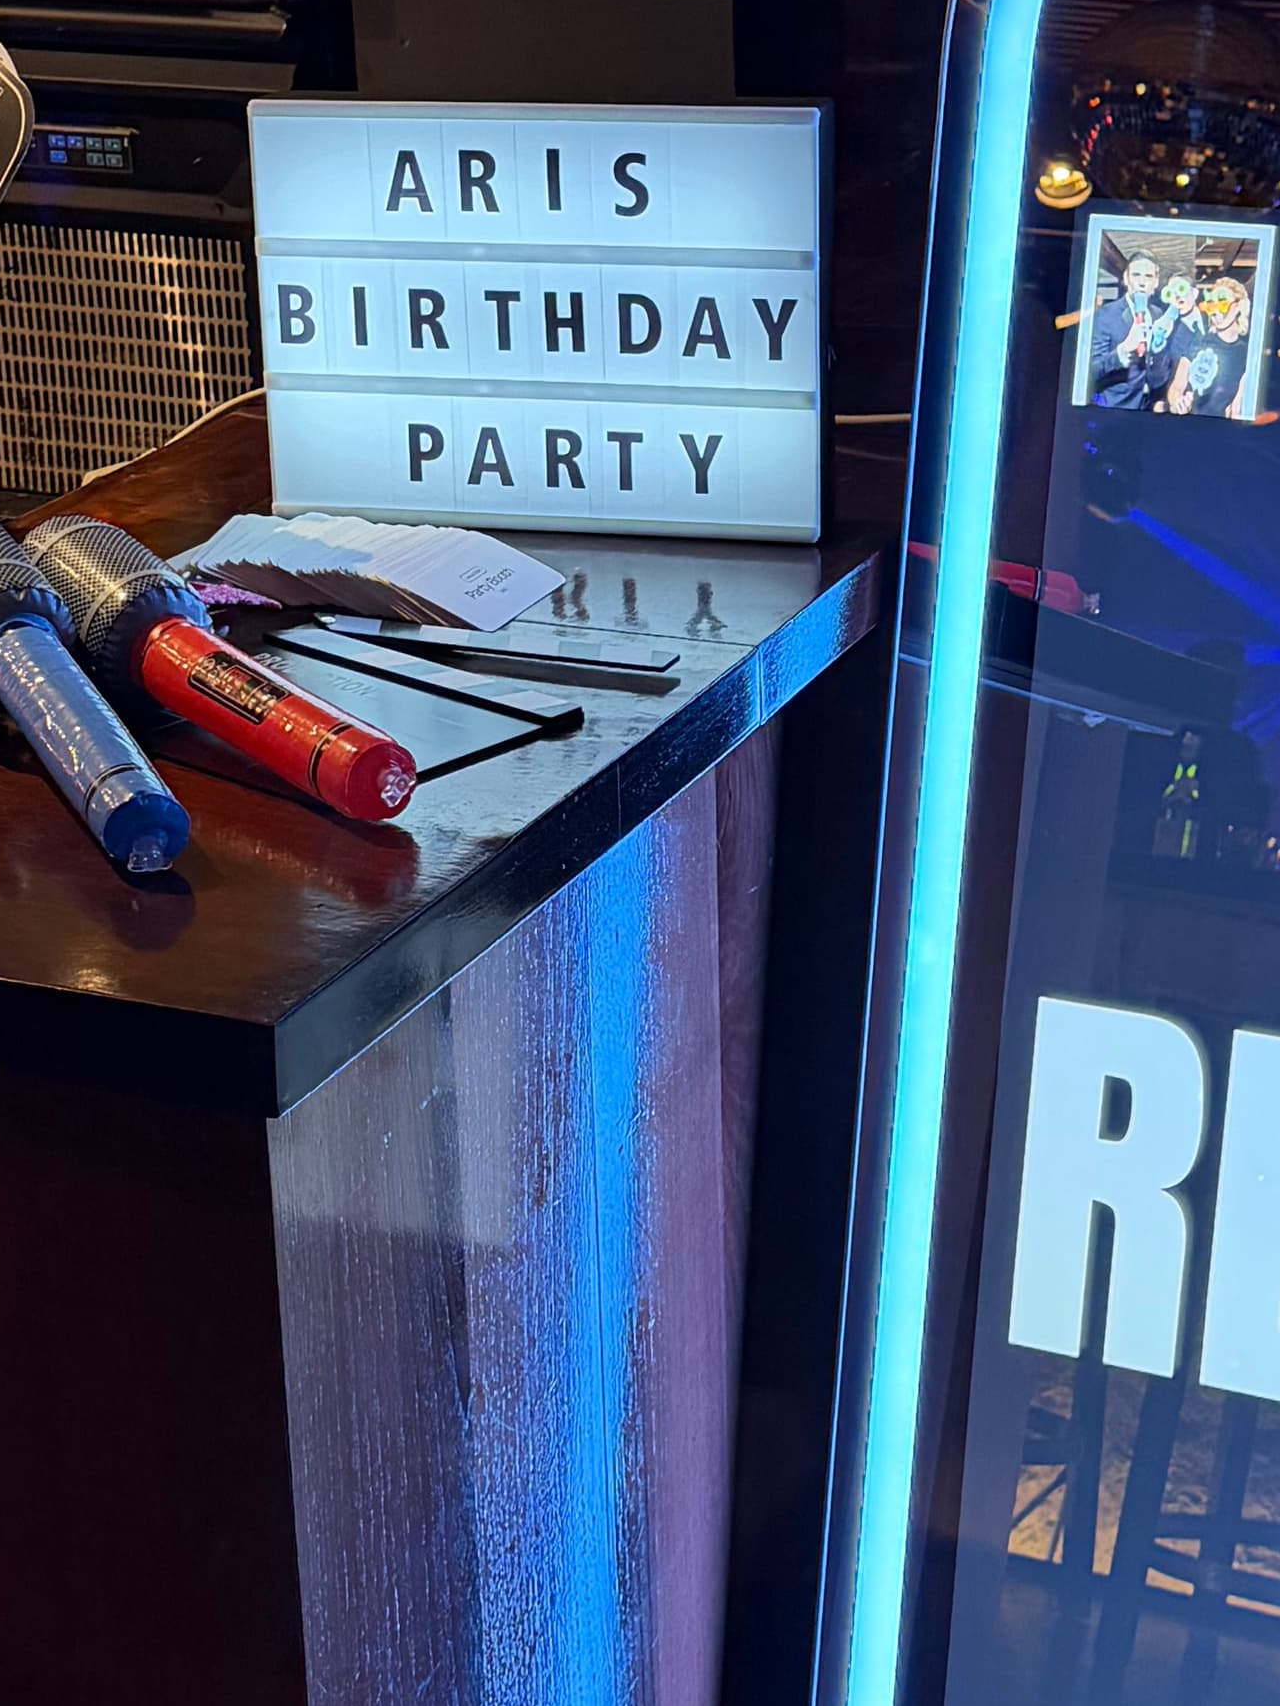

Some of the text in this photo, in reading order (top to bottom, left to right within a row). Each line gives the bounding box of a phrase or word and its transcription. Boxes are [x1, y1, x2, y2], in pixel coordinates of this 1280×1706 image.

[385, 147, 650, 217] ARIS
[277, 283, 799, 361] BIRTHDAY
[407, 422, 724, 495] PARTY
